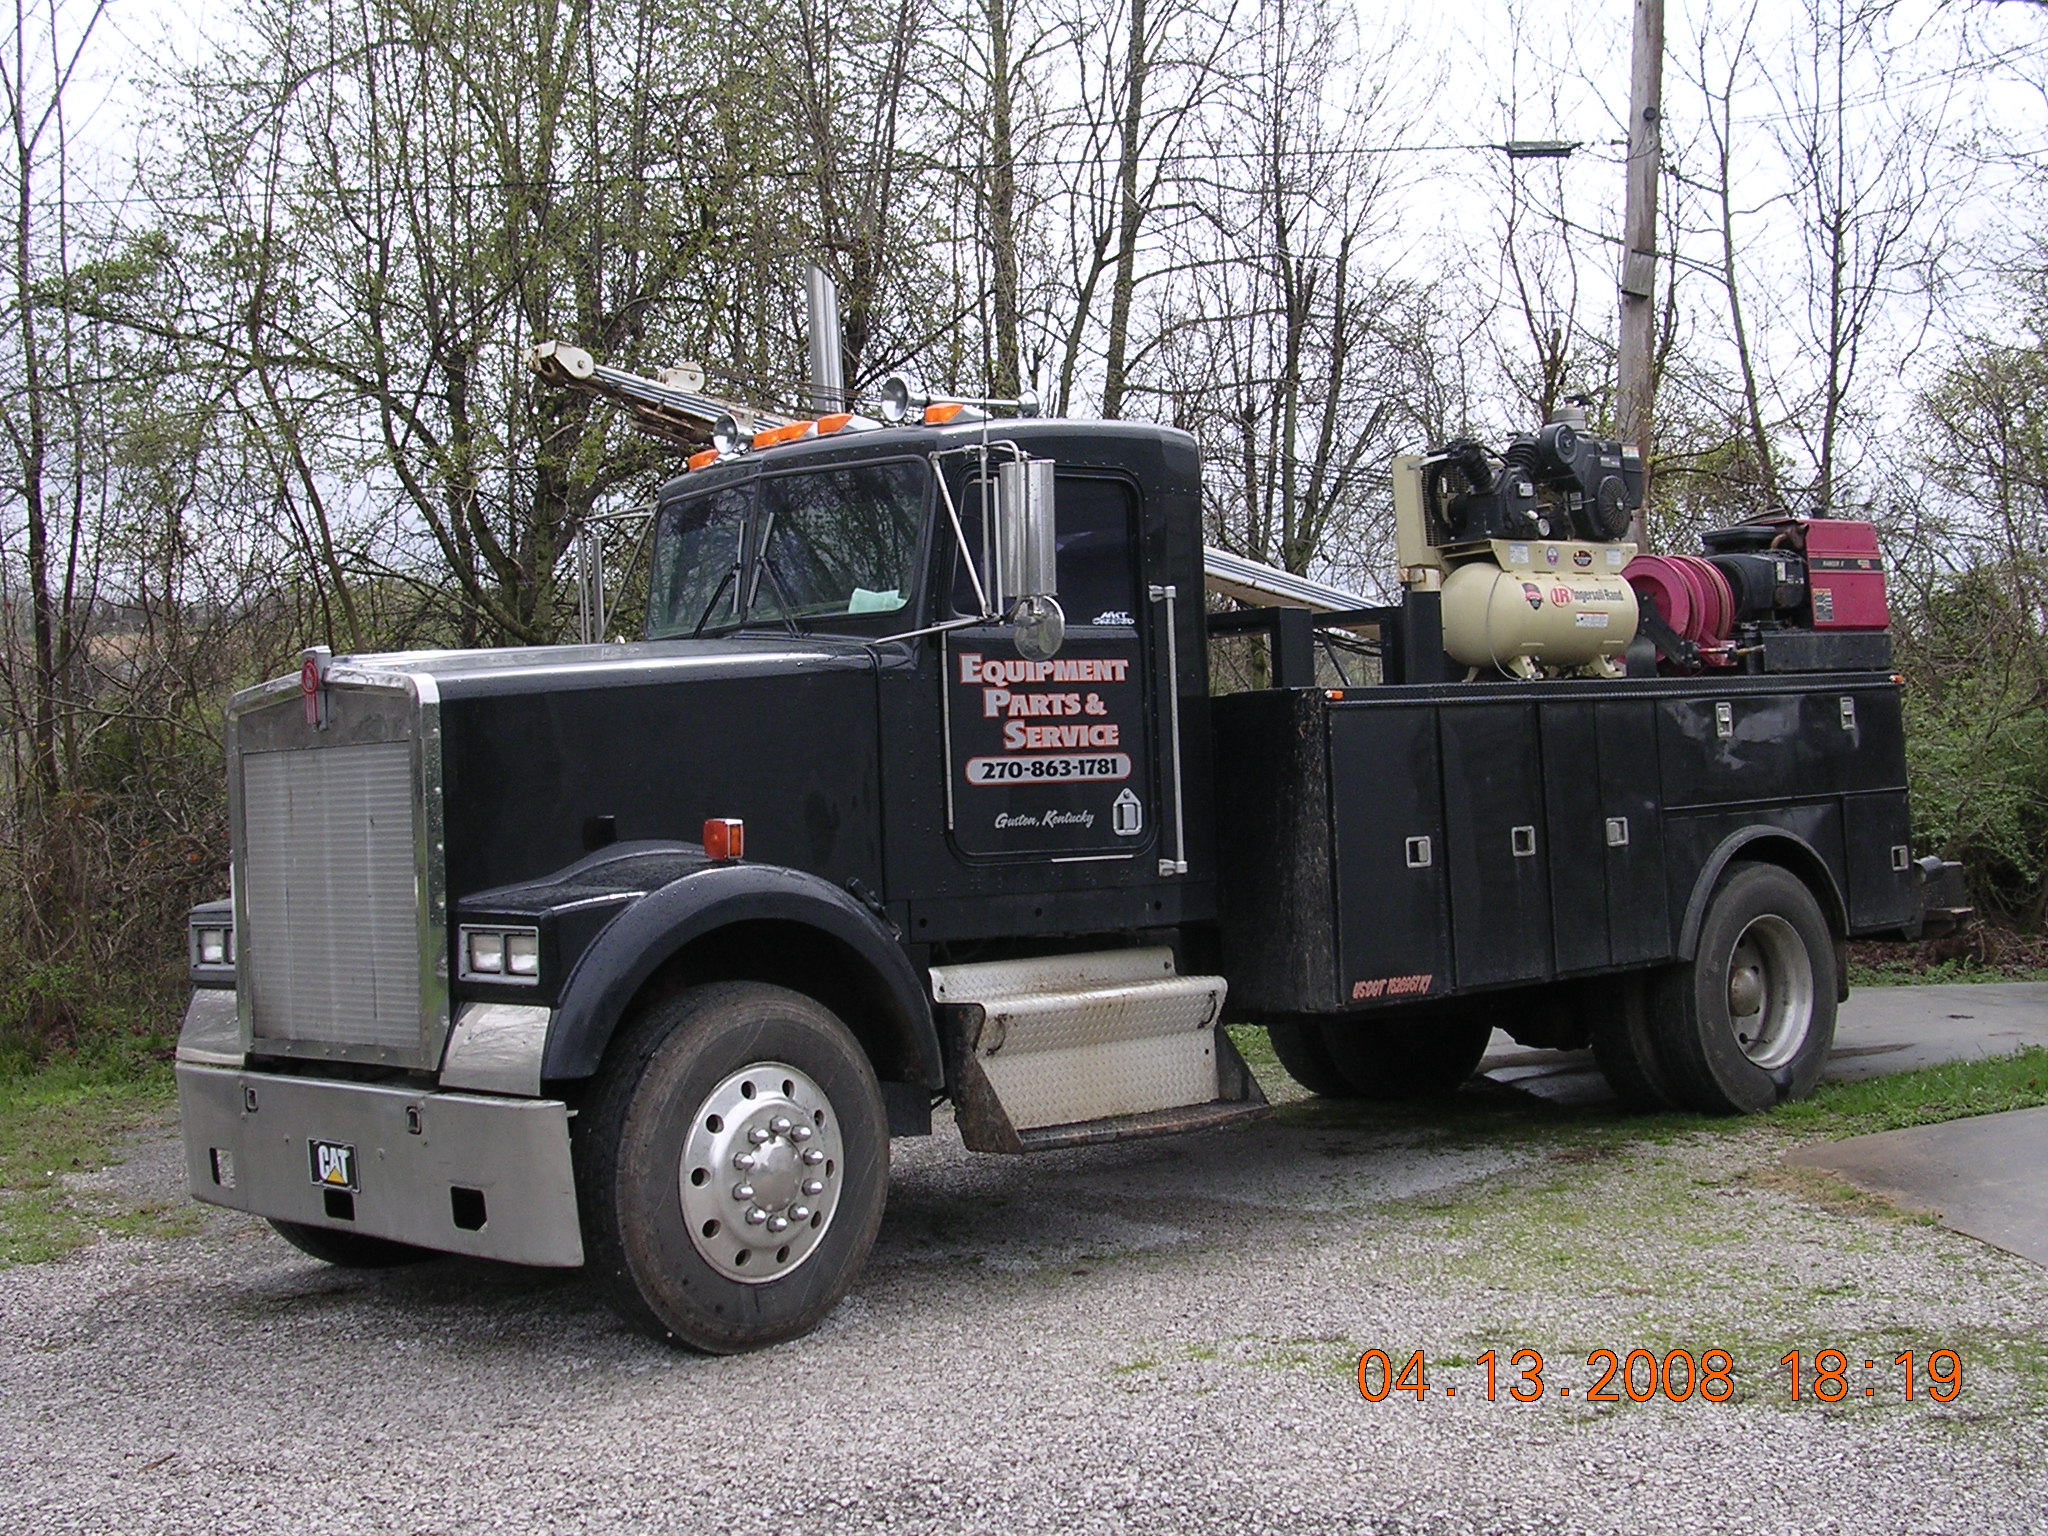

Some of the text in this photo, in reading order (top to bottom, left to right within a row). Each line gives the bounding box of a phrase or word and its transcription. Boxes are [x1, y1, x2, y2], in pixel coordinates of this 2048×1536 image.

[959, 653, 1129, 687] EQUIPMENT
[982, 687, 1108, 718] PARTS &
[1003, 719, 1120, 750] SERVICE
[981, 758, 1119, 780] 270-863-1781
[994, 809, 1094, 829] Guston, Kentucky
[1352, 979, 1387, 999] USDOT
[317, 1145, 351, 1184] CAT
